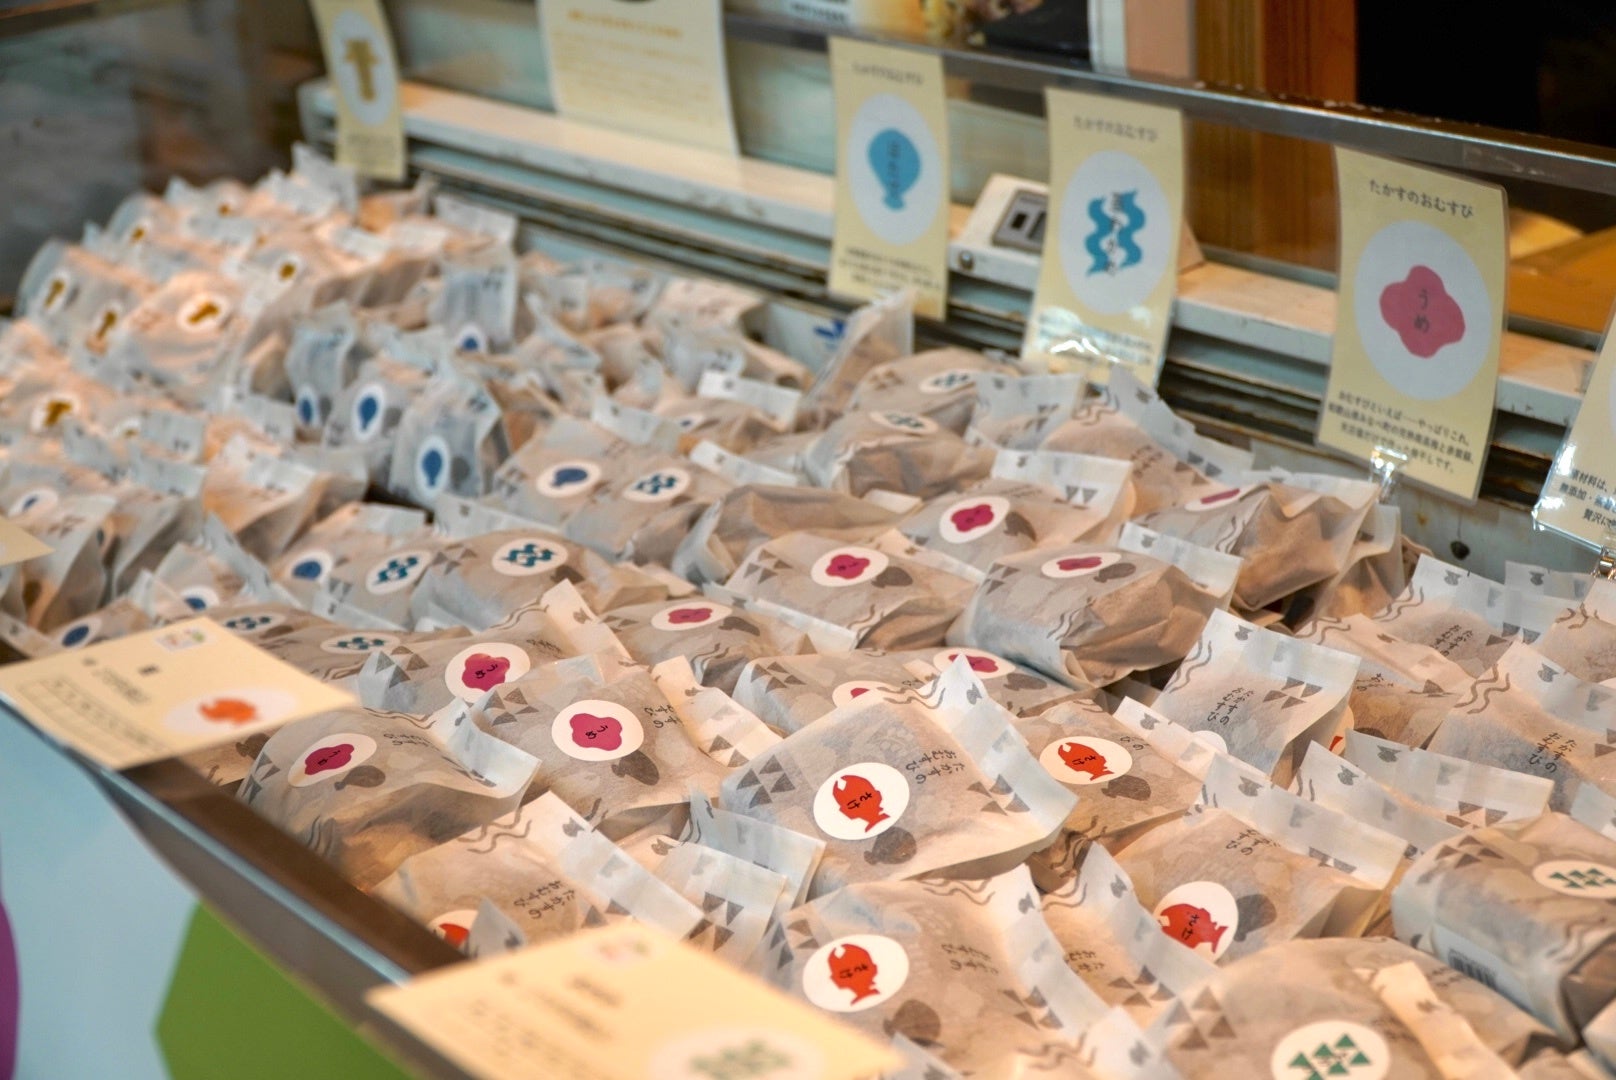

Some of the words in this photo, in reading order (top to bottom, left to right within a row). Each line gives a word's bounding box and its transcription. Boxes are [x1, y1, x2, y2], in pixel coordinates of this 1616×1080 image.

[1369, 179, 1475, 219] たかすのおむすび
[1414, 287, 1431, 334] うめ
[475, 663, 499, 679] うめ
[1207, 687, 1245, 722] おむすび
[1219, 690, 1255, 726] たかすの
[586, 725, 609, 740] うめ
[318, 749, 341, 766] うめ
[905, 749, 957, 773] おむすび
[1071, 755, 1097, 766] さけ
[1528, 732, 1563, 765] おむすび
[1544, 739, 1578, 774] たかすの
[915, 762, 966, 785] たかすの
[847, 791, 873, 811] さけ
[513, 879, 567, 908] おむすび
[528, 889, 576, 920] たかすの
[1181, 913, 1201, 941] さけ
[839, 963, 869, 980] さけ
